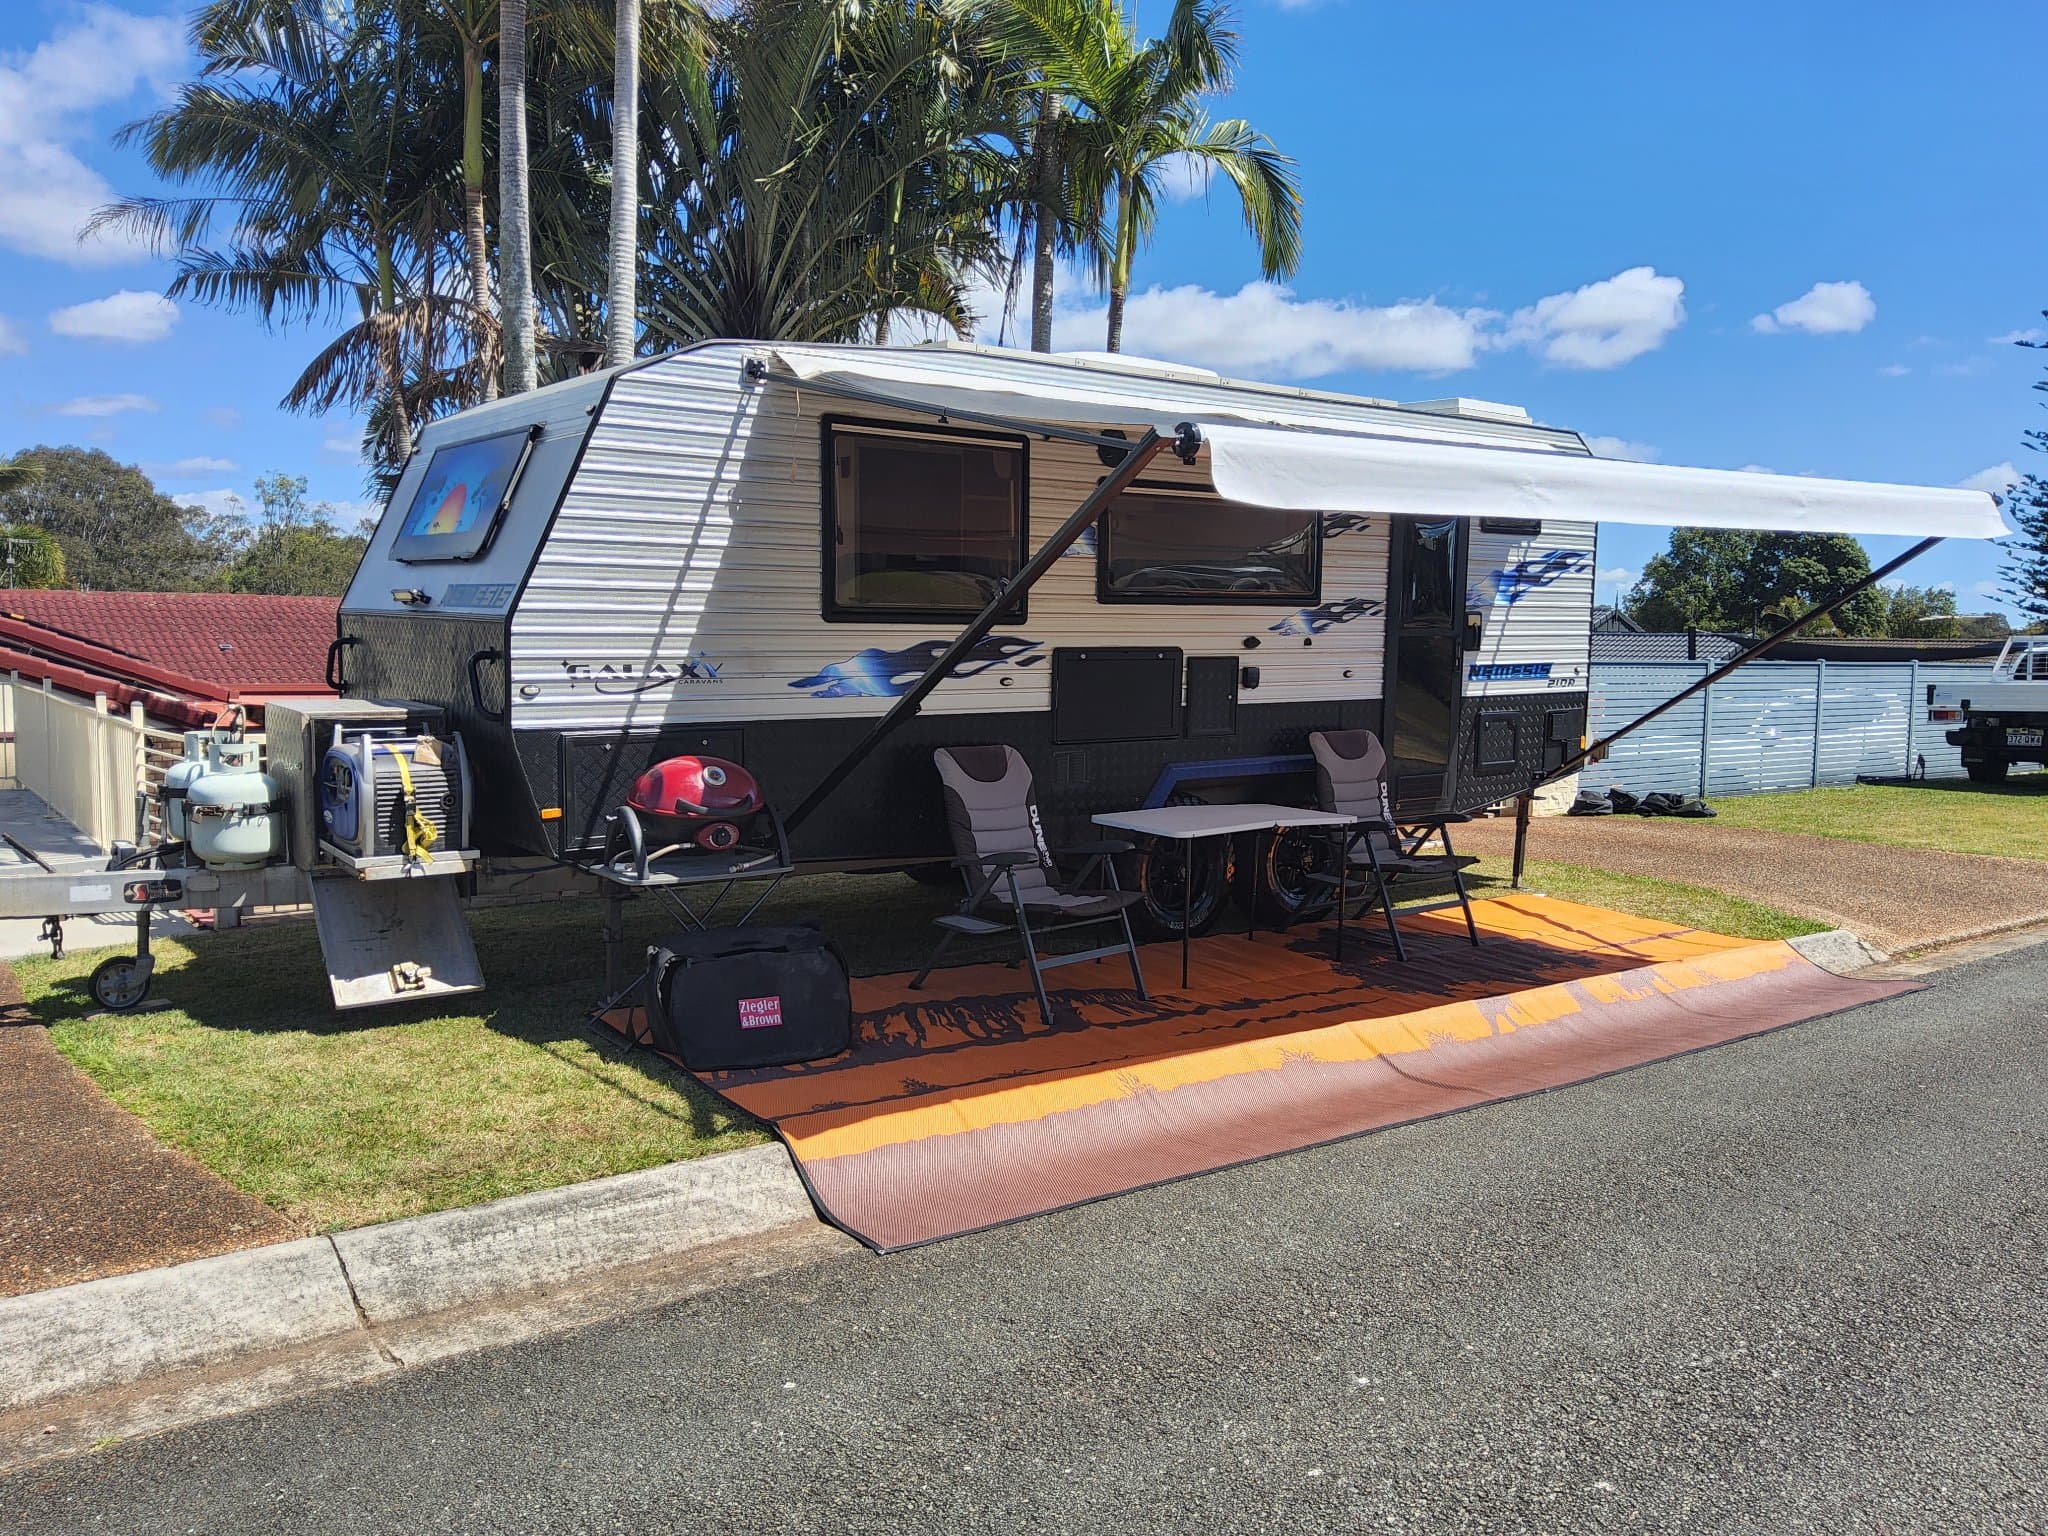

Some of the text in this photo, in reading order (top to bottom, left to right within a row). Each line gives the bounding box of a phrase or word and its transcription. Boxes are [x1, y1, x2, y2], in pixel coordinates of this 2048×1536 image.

[441, 584, 518, 609] NESIS
[566, 658, 724, 679] GALAXY
[1468, 663, 1552, 681] NEMESIS
[1380, 781, 1393, 821] DUNE
[1029, 804, 1048, 851] DUNE
[739, 999, 779, 1014] Ziegler
[742, 1014, 780, 1026] &Brown
